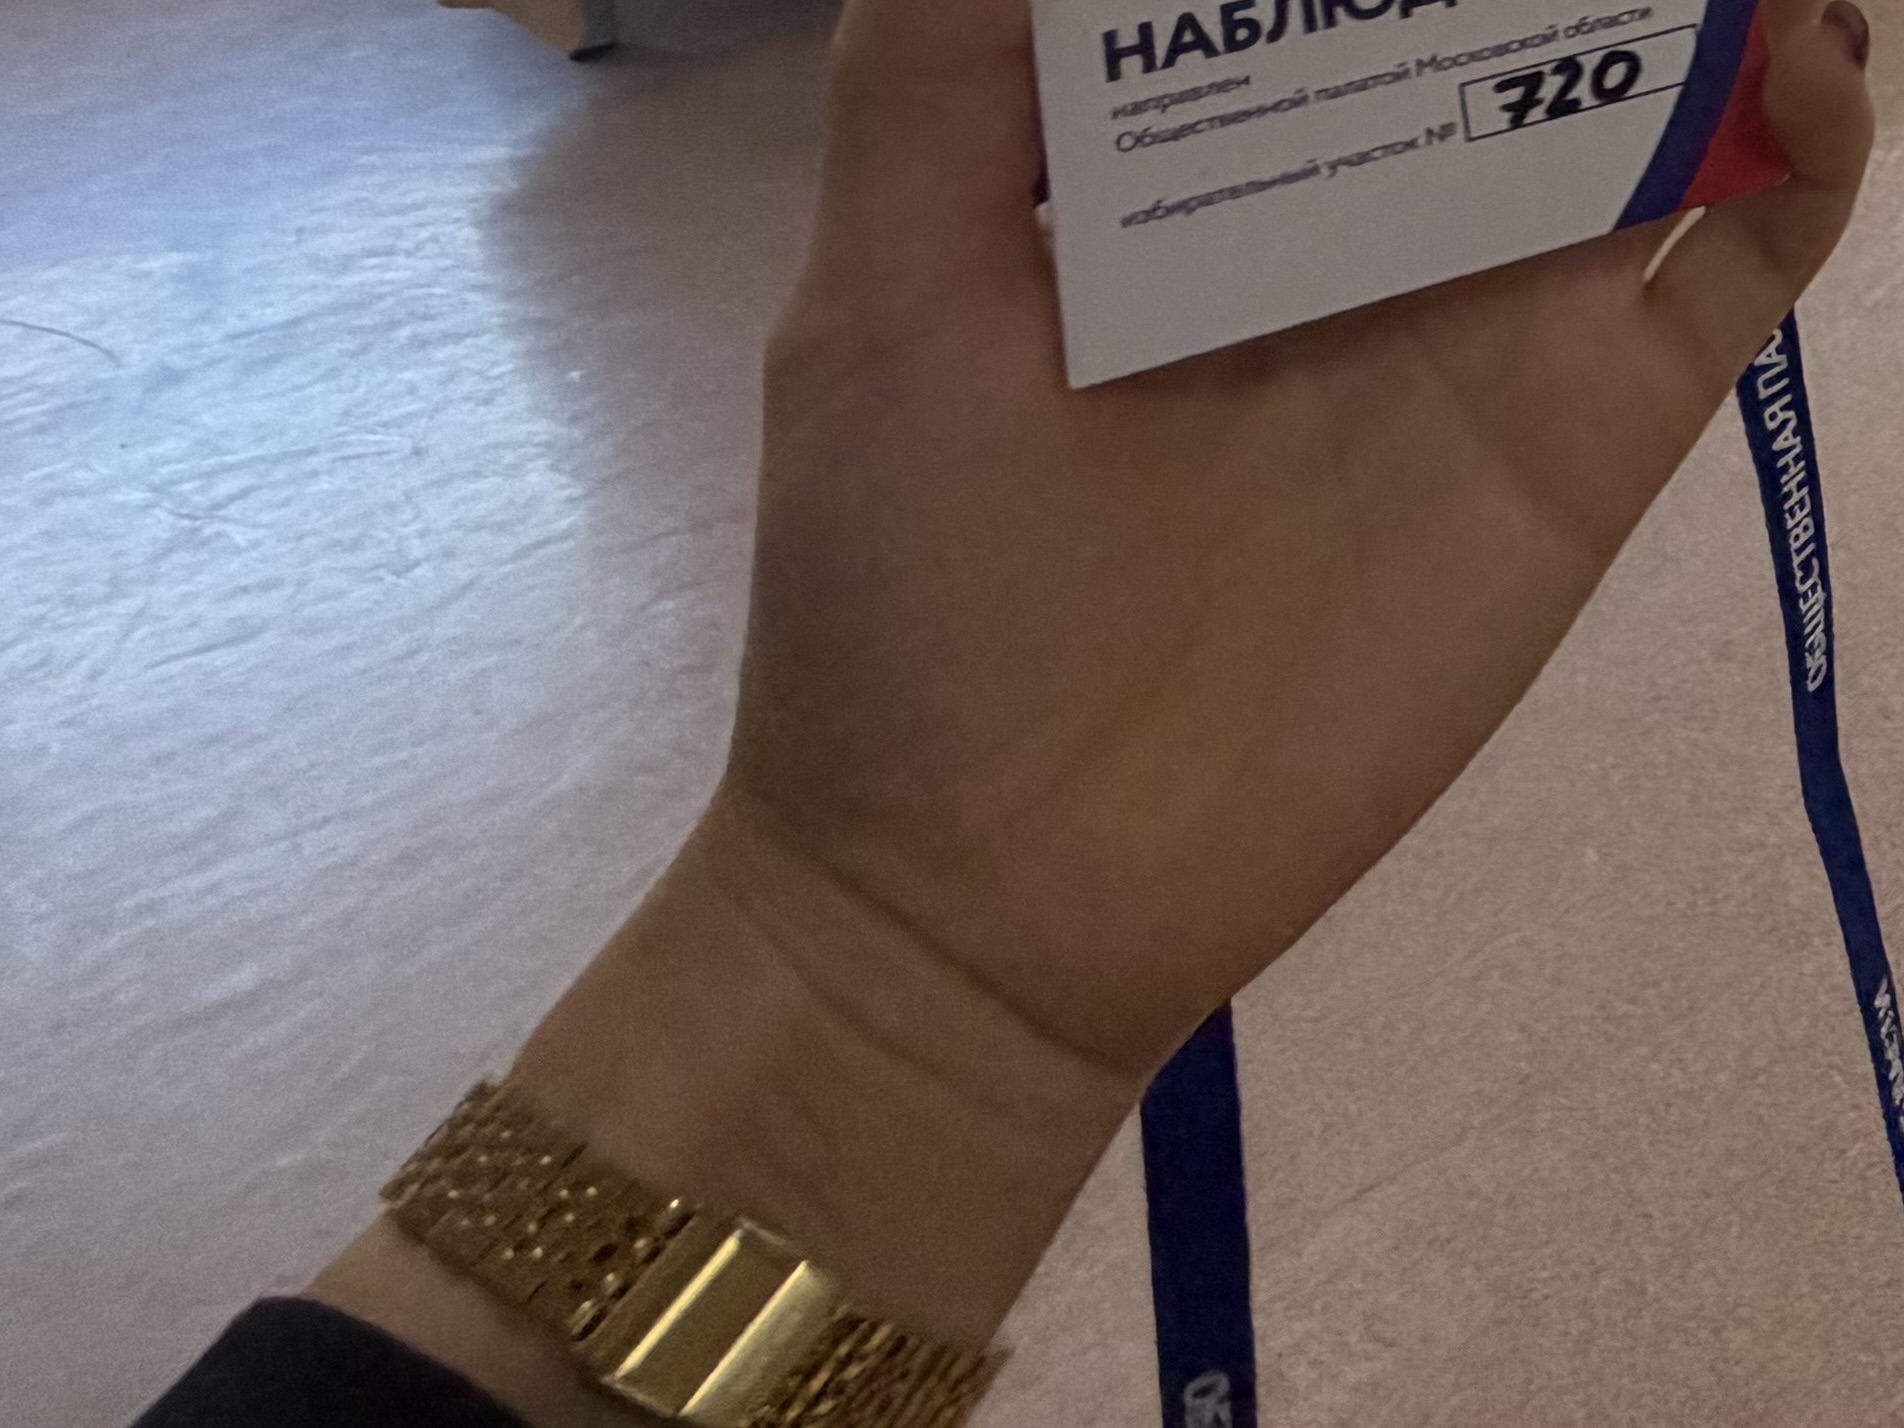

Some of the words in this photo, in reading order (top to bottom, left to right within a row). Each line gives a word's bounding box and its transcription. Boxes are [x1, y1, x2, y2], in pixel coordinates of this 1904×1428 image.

[1115, 87, 1310, 153] Общественной
[1416, 25, 1559, 77] Московской
[1563, 6, 1654, 40] области
[1492, 49, 1642, 130] 720
[1752, 328, 1791, 401] ПА
[1763, 394, 1828, 693] ОБЩЕСТВЕННАЯ
